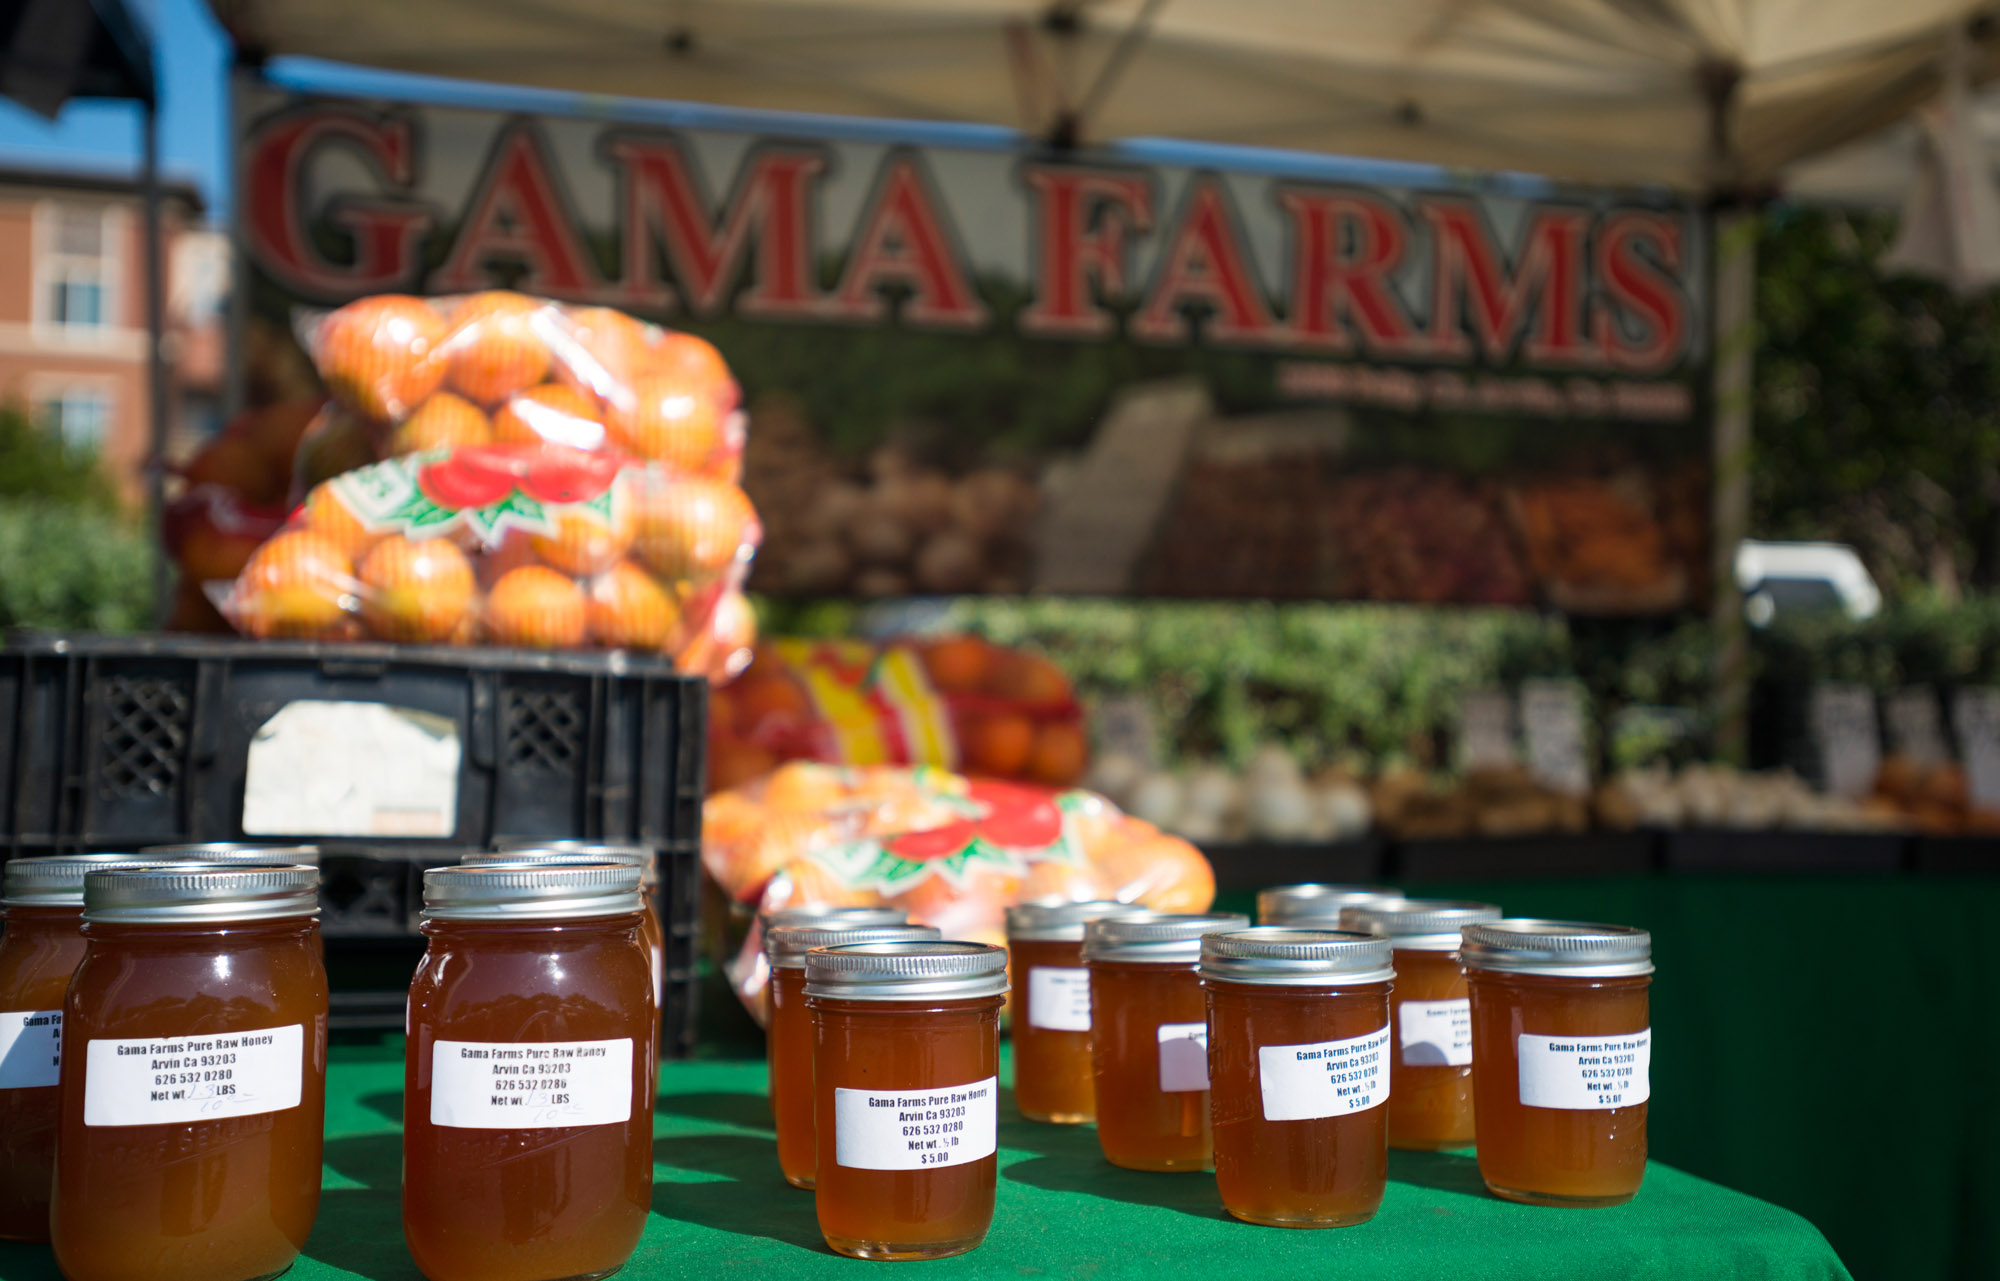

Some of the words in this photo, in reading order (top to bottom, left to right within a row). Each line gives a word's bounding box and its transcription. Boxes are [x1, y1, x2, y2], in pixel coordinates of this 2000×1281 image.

[242, 108, 988, 328] GAMA
[1018, 165, 1688, 371] FARMS
[23, 1017, 49, 1026] Gama
[117, 1045, 147, 1056] Gama
[150, 1043, 184, 1054] Farms
[188, 1041, 212, 1052] Pure
[216, 1038, 238, 1049] Raw
[242, 1035, 273, 1047] Honey
[1297, 1051, 1322, 1061] Gama
[1324, 1047, 1349, 1058] Farms
[1351, 1043, 1367, 1054] Pure
[1368, 1040, 1379, 1050] Raw
[1550, 1043, 1575, 1052] Gama
[1577, 1043, 1602, 1052] Farms
[1605, 1043, 1621, 1051] Pure
[1623, 1042, 1636, 1050] Raw
[461, 1048, 489, 1059] Gama
[492, 1049, 523, 1059] Farms
[553, 1048, 573, 1058] Raw
[1579, 1057, 1600, 1065] Arvin
[1603, 1056, 1612, 1064] Ca
[152, 1058, 180, 1070] Arvin
[184, 1057, 197, 1068] Ca
[201, 1053, 236, 1067] 93203
[493, 1065, 519, 1075] Arvin
[523, 1064, 535, 1074] Ca
[539, 1063, 571, 1074] 93203
[1327, 1061, 1348, 1071] Arvin
[1350, 1058, 1359, 1068] Ca
[1361, 1052, 1379, 1065] 93203
[155, 1074, 176, 1085] 626
[180, 1072, 200, 1084] 532
[205, 1069, 232, 1082] 0280
[1331, 1074, 1347, 1085] 626
[1349, 1070, 1362, 1081] 532
[1582, 1069, 1598, 1079] 626
[1601, 1069, 1615, 1078] 532
[496, 1080, 515, 1090] 626
[518, 1080, 538, 1090] 532
[1337, 1087, 1351, 1097] Net
[1587, 1082, 1601, 1091] Net
[151, 1090, 168, 1102] Net
[173, 1090, 185, 1099] wt
[217, 1084, 236, 1096] LBS
[491, 1096, 508, 1106] Net
[552, 1094, 570, 1104] LBS
[869, 1097, 895, 1108] Gama
[898, 1097, 926, 1107] Farms
[929, 1095, 949, 1106] Pure
[951, 1093, 967, 1103] Raw
[969, 1088, 987, 1100] Honey
[899, 1112, 923, 1122] Arvin
[926, 1111, 938, 1120] Ca
[940, 1106, 966, 1119] 93203
[903, 1126, 921, 1136] 626
[924, 1124, 941, 1135] 532
[943, 1121, 964, 1133] 0280
[908, 1140, 924, 1151] Net
[952, 1136, 959, 1146] lb
